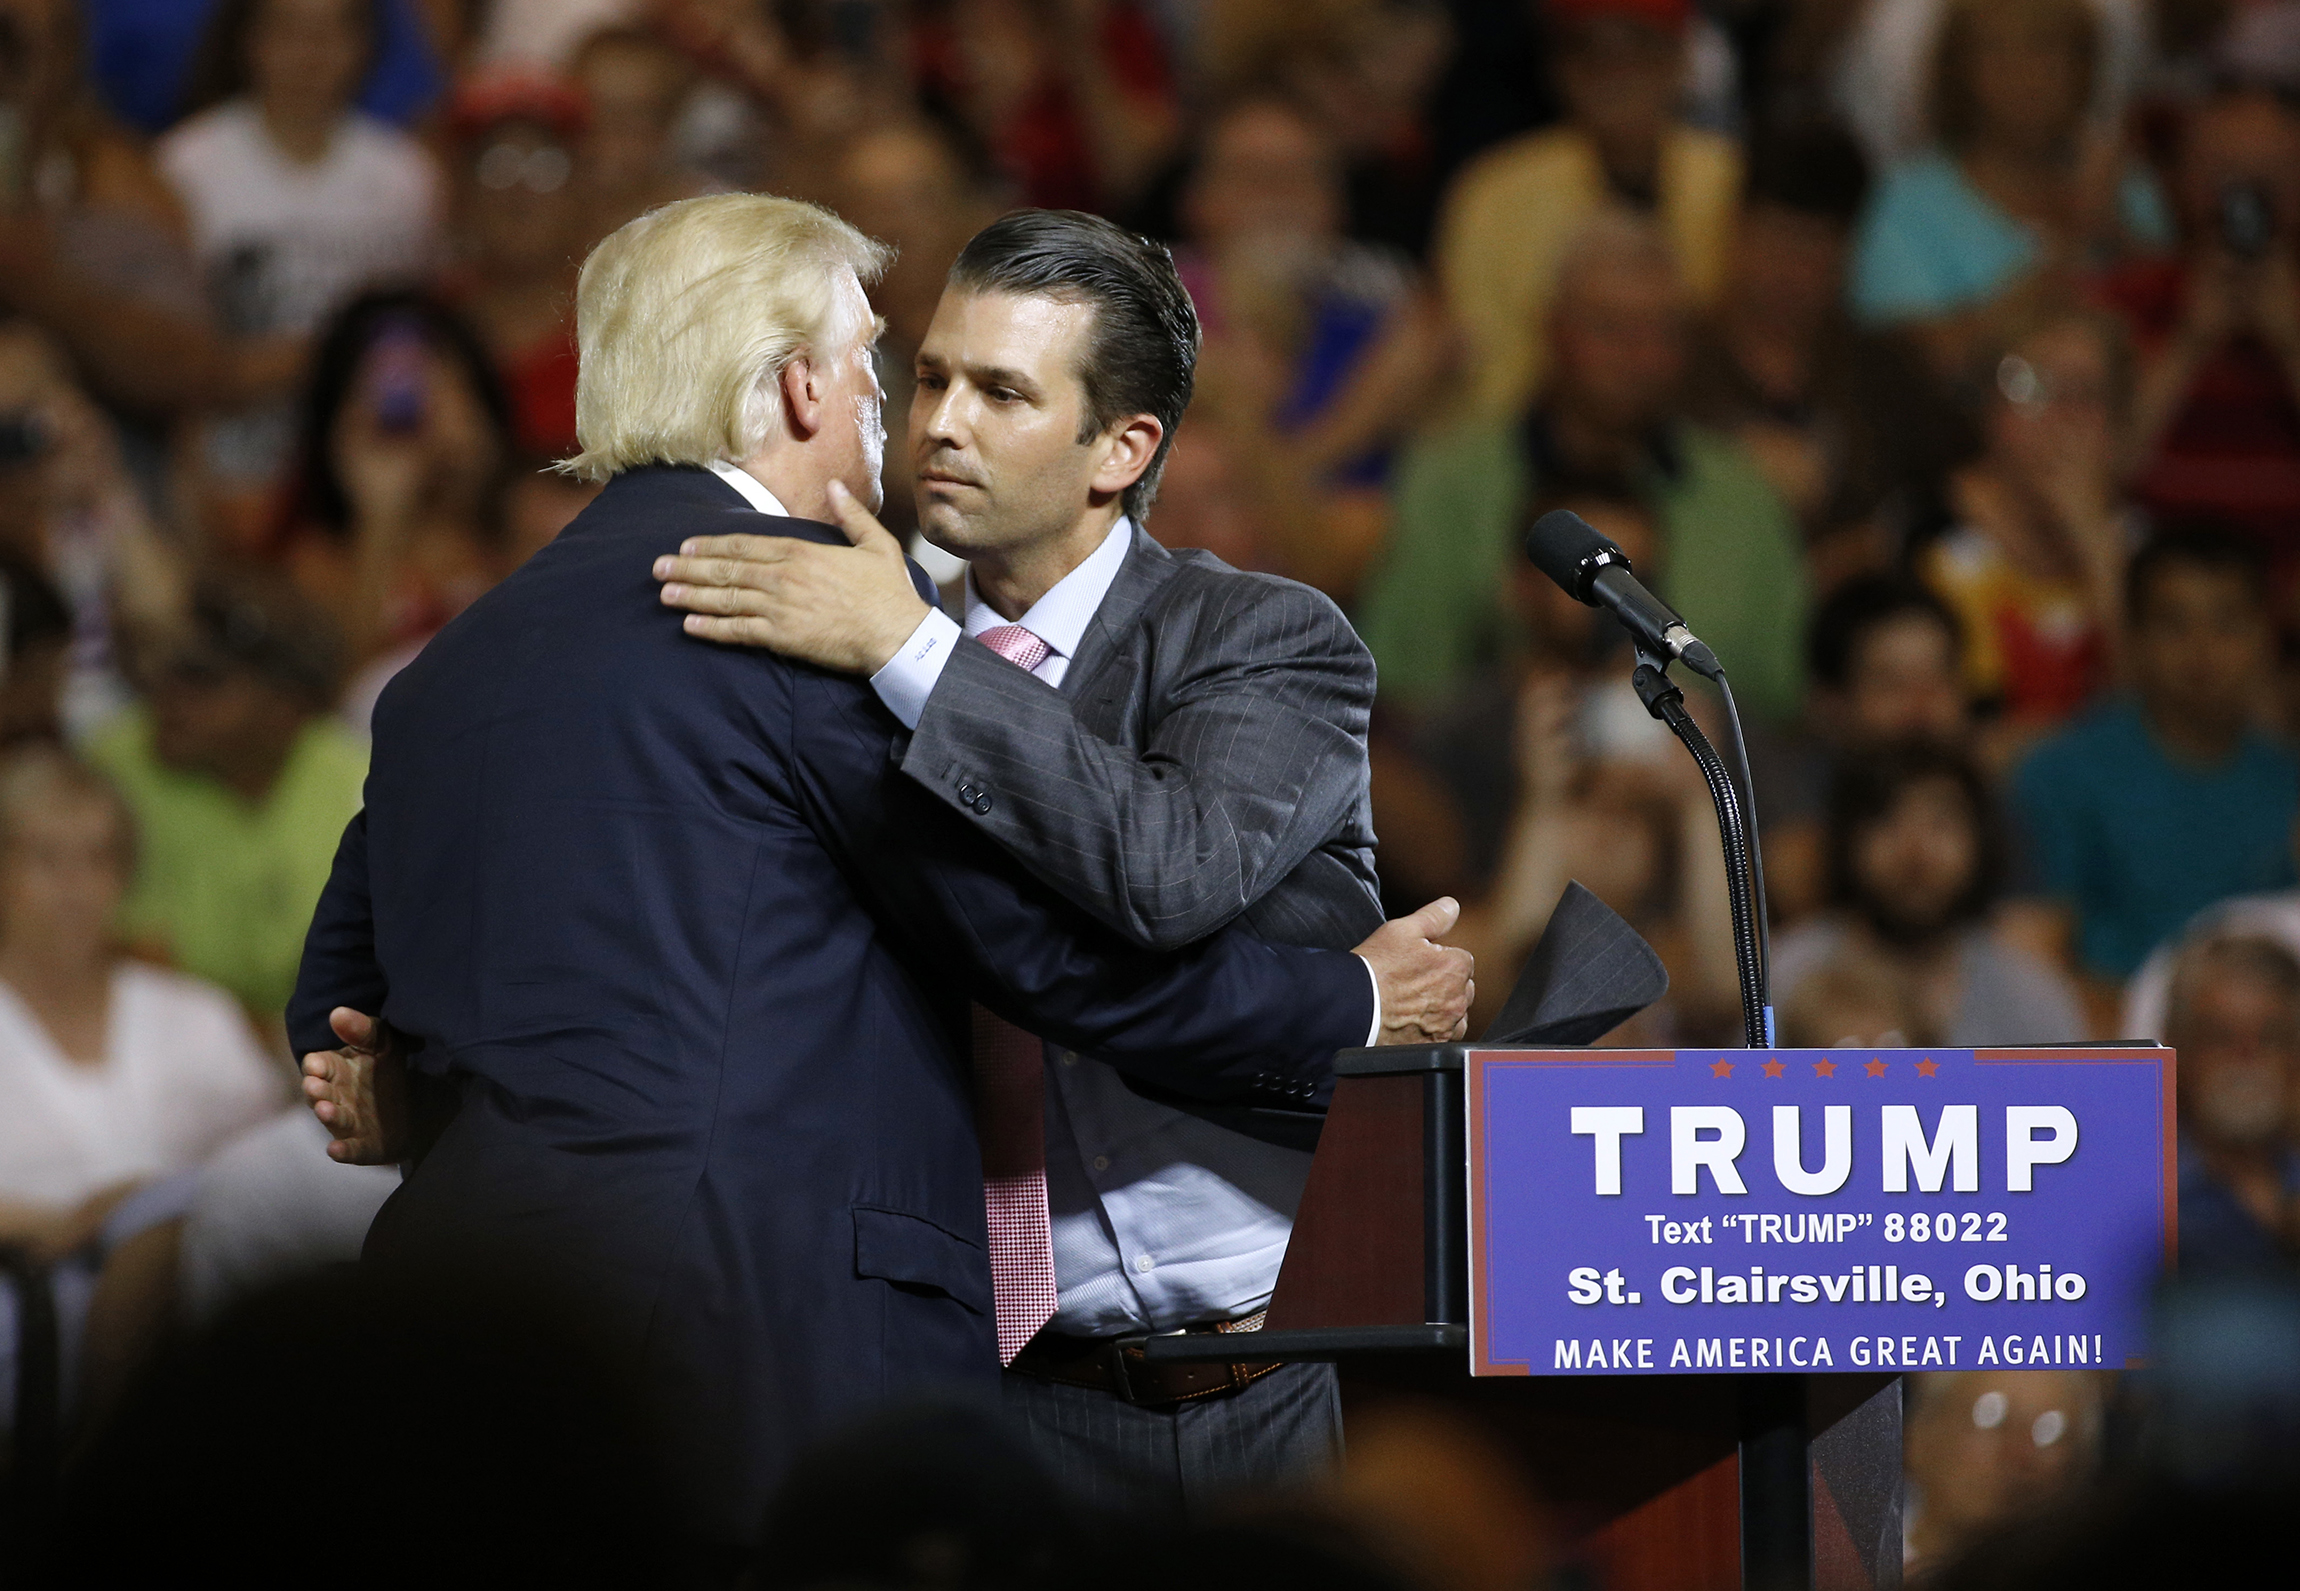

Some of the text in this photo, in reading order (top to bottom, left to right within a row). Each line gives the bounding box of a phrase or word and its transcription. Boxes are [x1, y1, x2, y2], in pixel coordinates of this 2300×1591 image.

[1570, 1104, 2078, 1196] TRUMP
[1645, 1211, 2008, 1244] Text “TRUMP” 88022
[1567, 1264, 2086, 1309] St. Clairsville, Ohio
[1554, 1334, 2102, 1369] MAKE AMERICA GREAT AGAIN!
